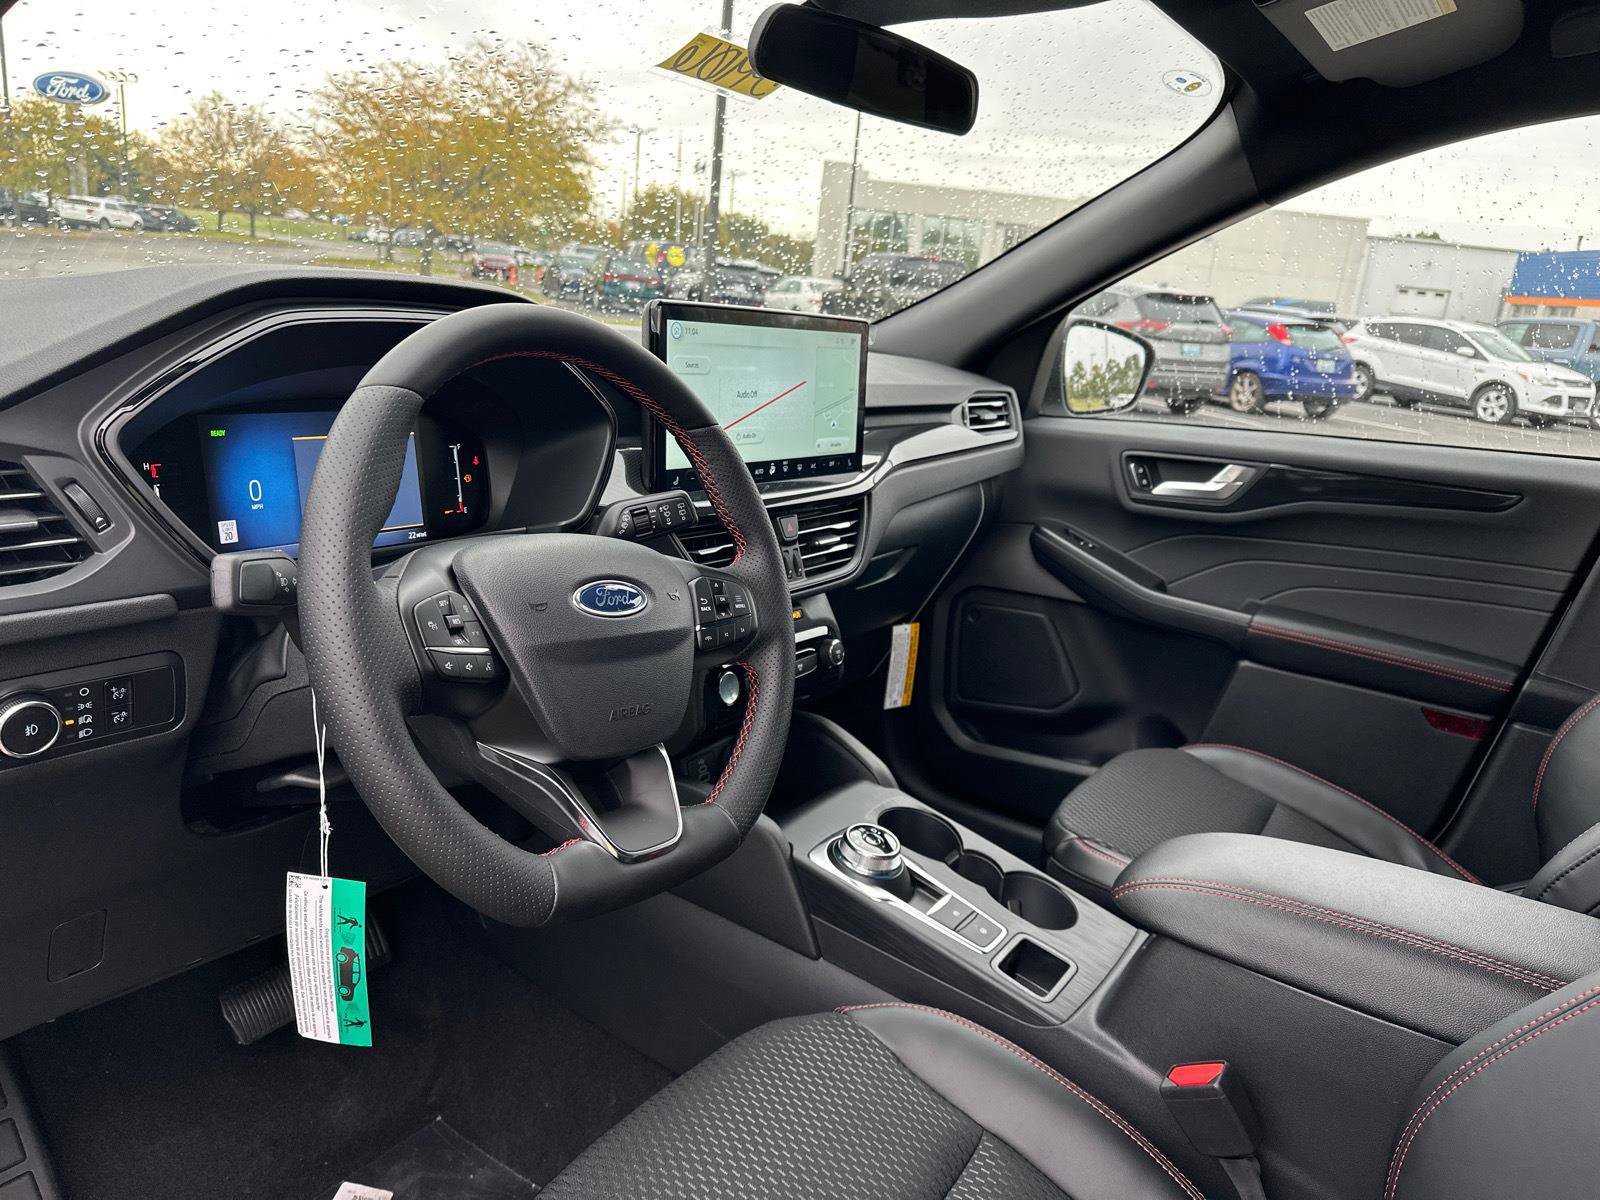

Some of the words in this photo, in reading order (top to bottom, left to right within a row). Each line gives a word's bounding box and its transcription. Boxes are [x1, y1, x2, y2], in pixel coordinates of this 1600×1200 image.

[46, 76, 91, 99] Ford
[736, 390, 749, 399] Audio
[750, 390, 758, 398] Off
[143, 462, 150, 471] H
[249, 479, 262, 502] 0
[224, 532, 234, 541] 20
[596, 585, 633, 607] Ford
[609, 703, 651, 721] AIRBAG
